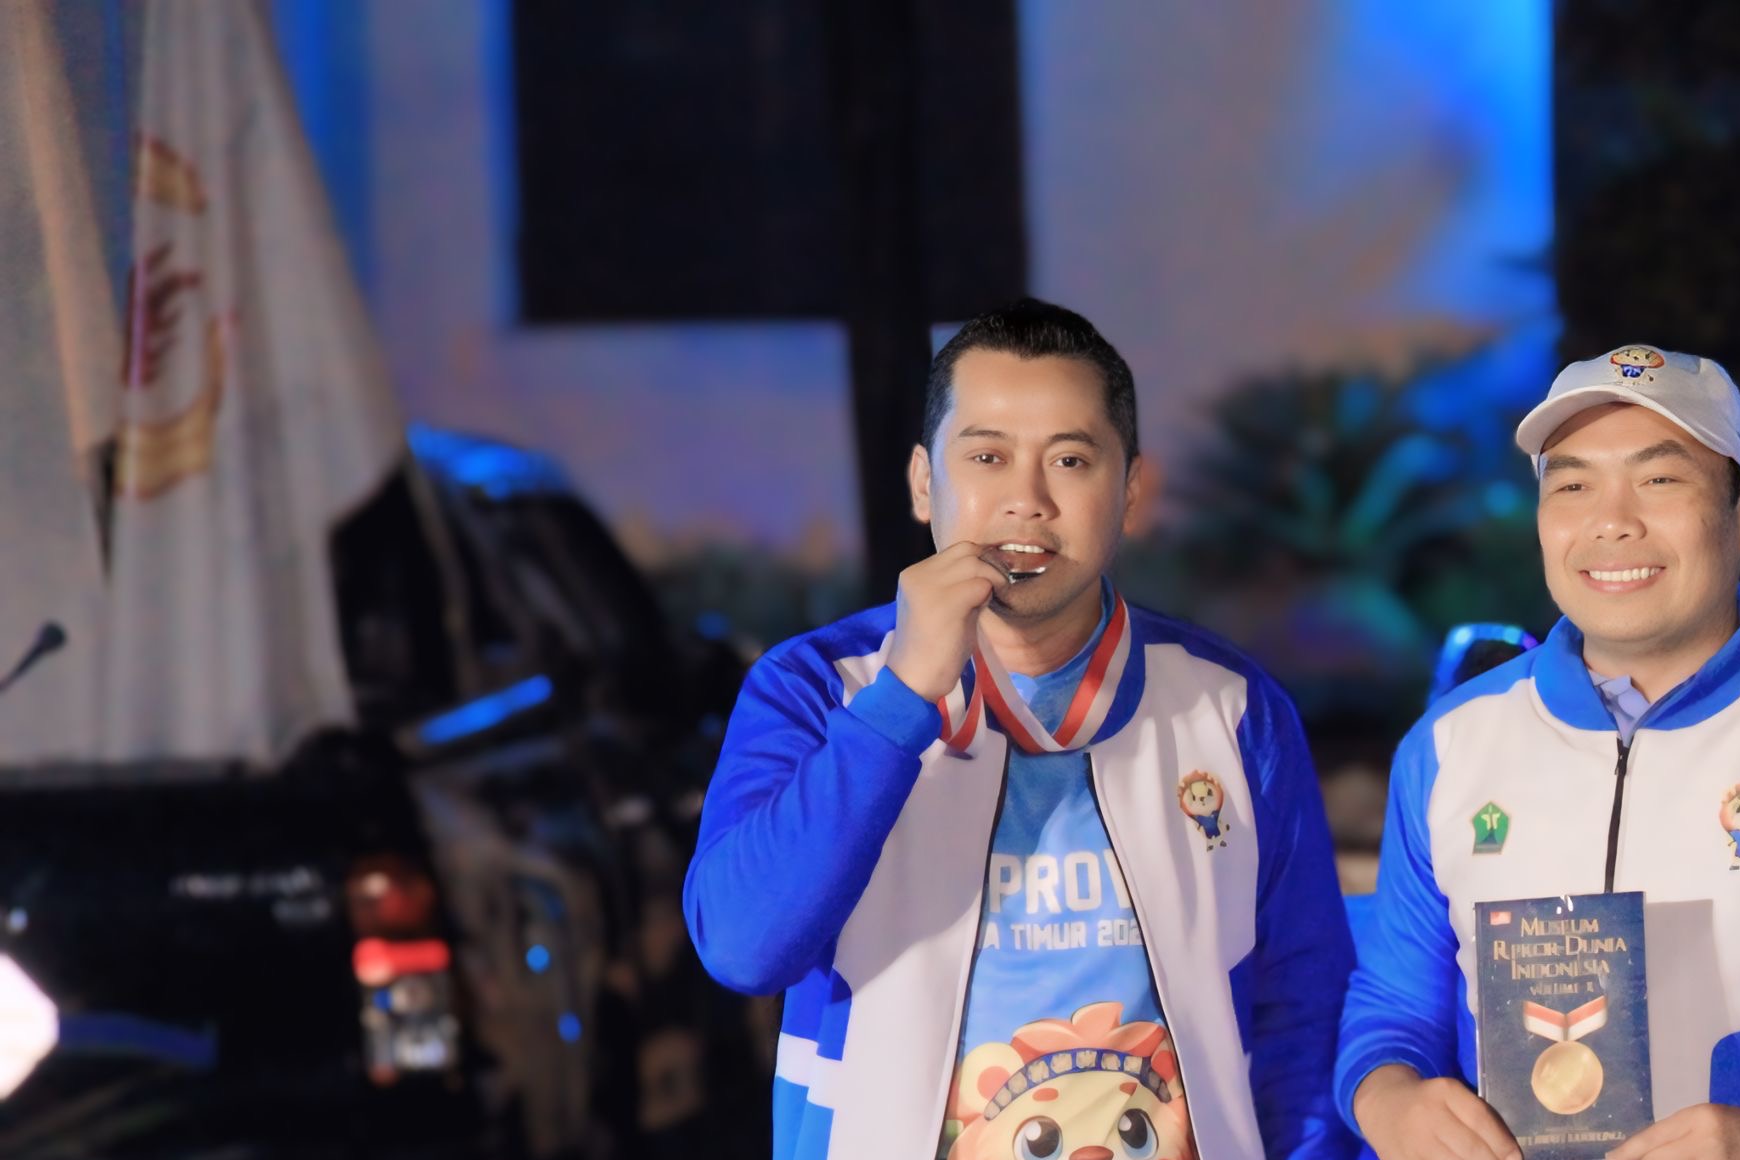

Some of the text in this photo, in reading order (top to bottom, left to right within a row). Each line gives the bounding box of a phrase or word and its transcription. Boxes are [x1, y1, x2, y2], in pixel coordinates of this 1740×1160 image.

[1011, 921, 1087, 950] TIMUR
[1521, 917, 1599, 937] MUSEUM
[1511, 959, 1610, 980] INDONESIA
